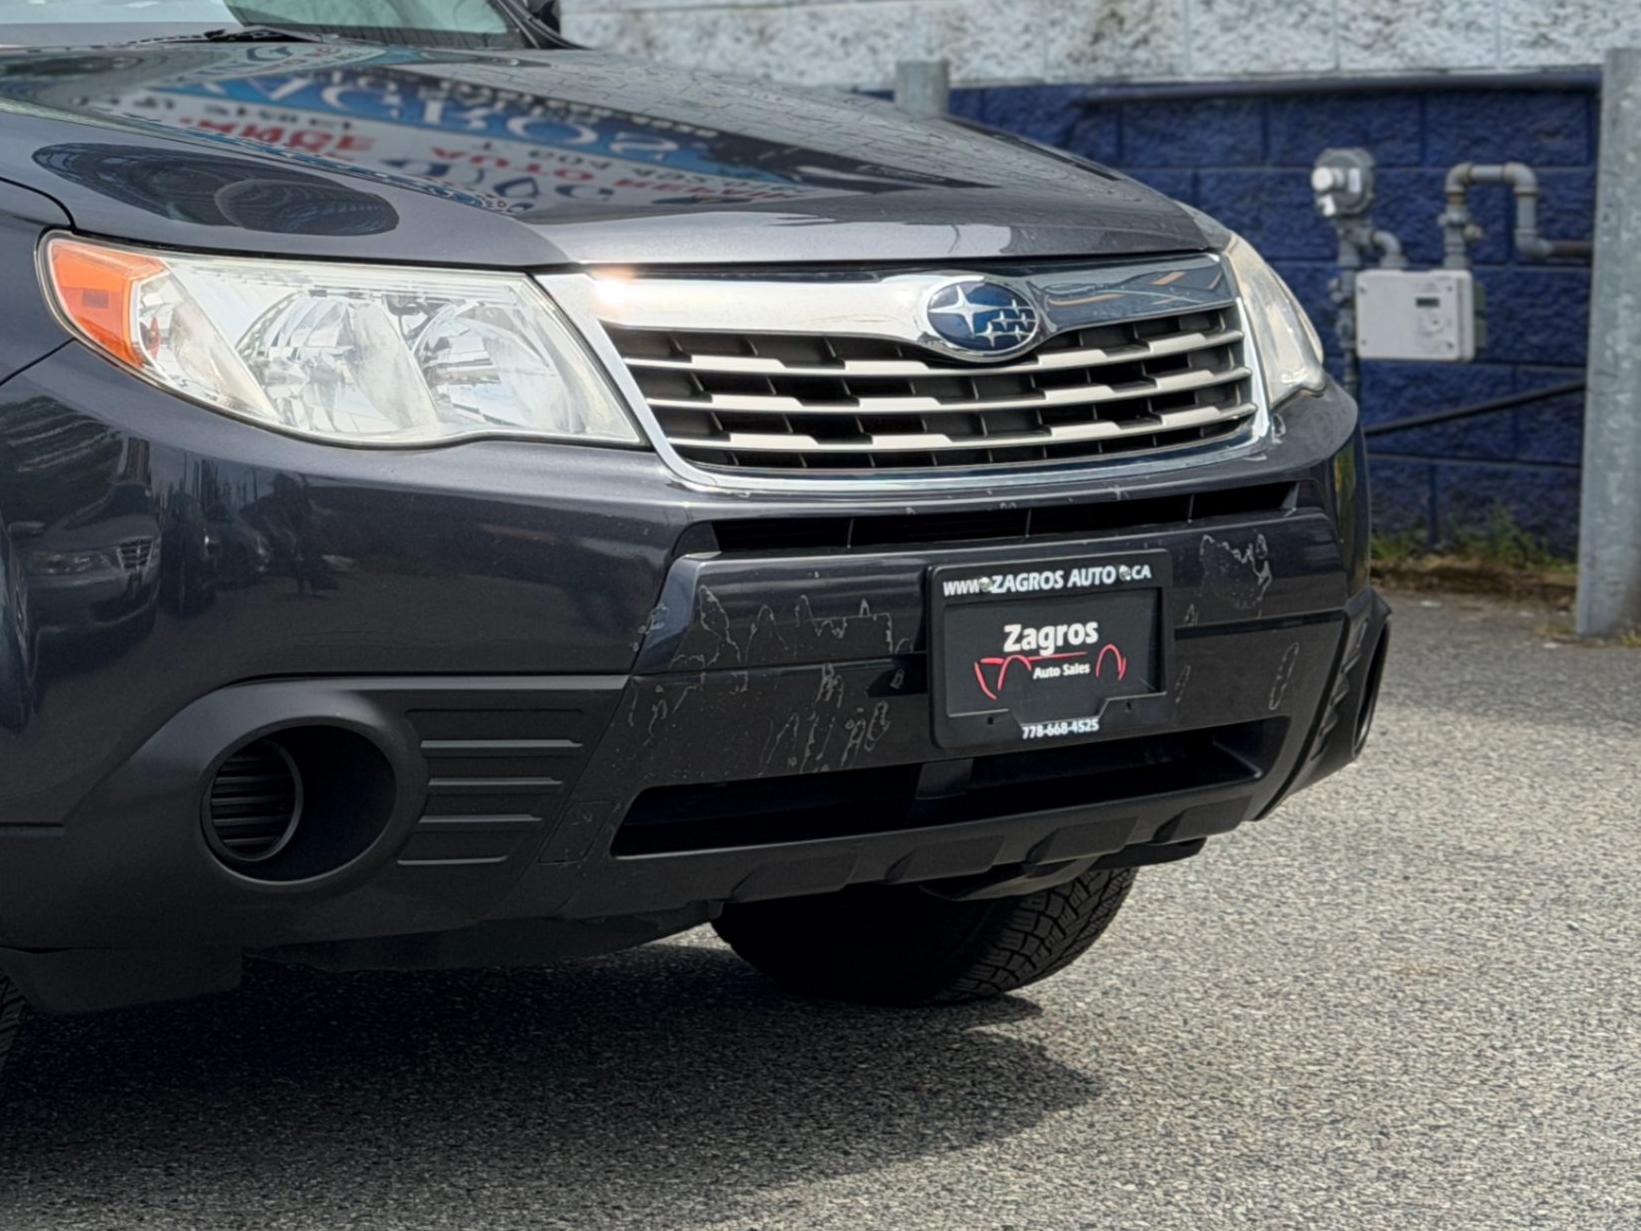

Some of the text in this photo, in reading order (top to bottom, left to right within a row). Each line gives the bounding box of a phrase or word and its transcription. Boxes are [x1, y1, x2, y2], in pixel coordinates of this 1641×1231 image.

[1003, 622, 1099, 656] Zagros
[1033, 663, 1091, 680] Auto Sales
[1022, 718, 1100, 740] 778-668-4525
